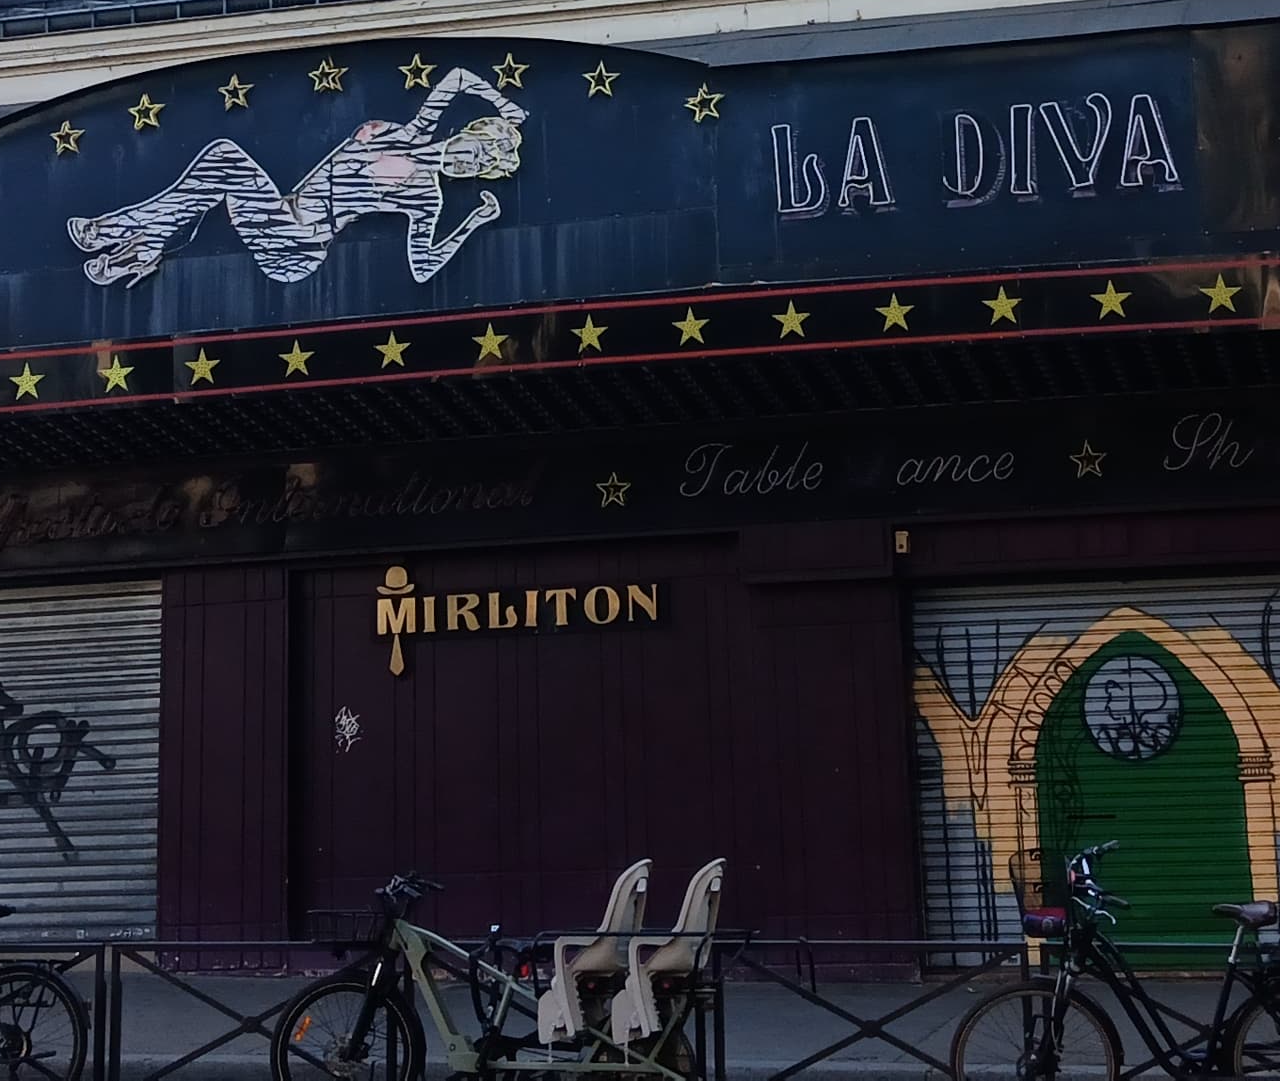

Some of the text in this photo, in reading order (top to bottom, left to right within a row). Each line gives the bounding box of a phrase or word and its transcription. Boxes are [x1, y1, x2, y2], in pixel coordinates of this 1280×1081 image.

[772, 92, 1179, 214] LA DIVA
[679, 440, 825, 498] Table
[376, 583, 658, 636] MIRLITON
